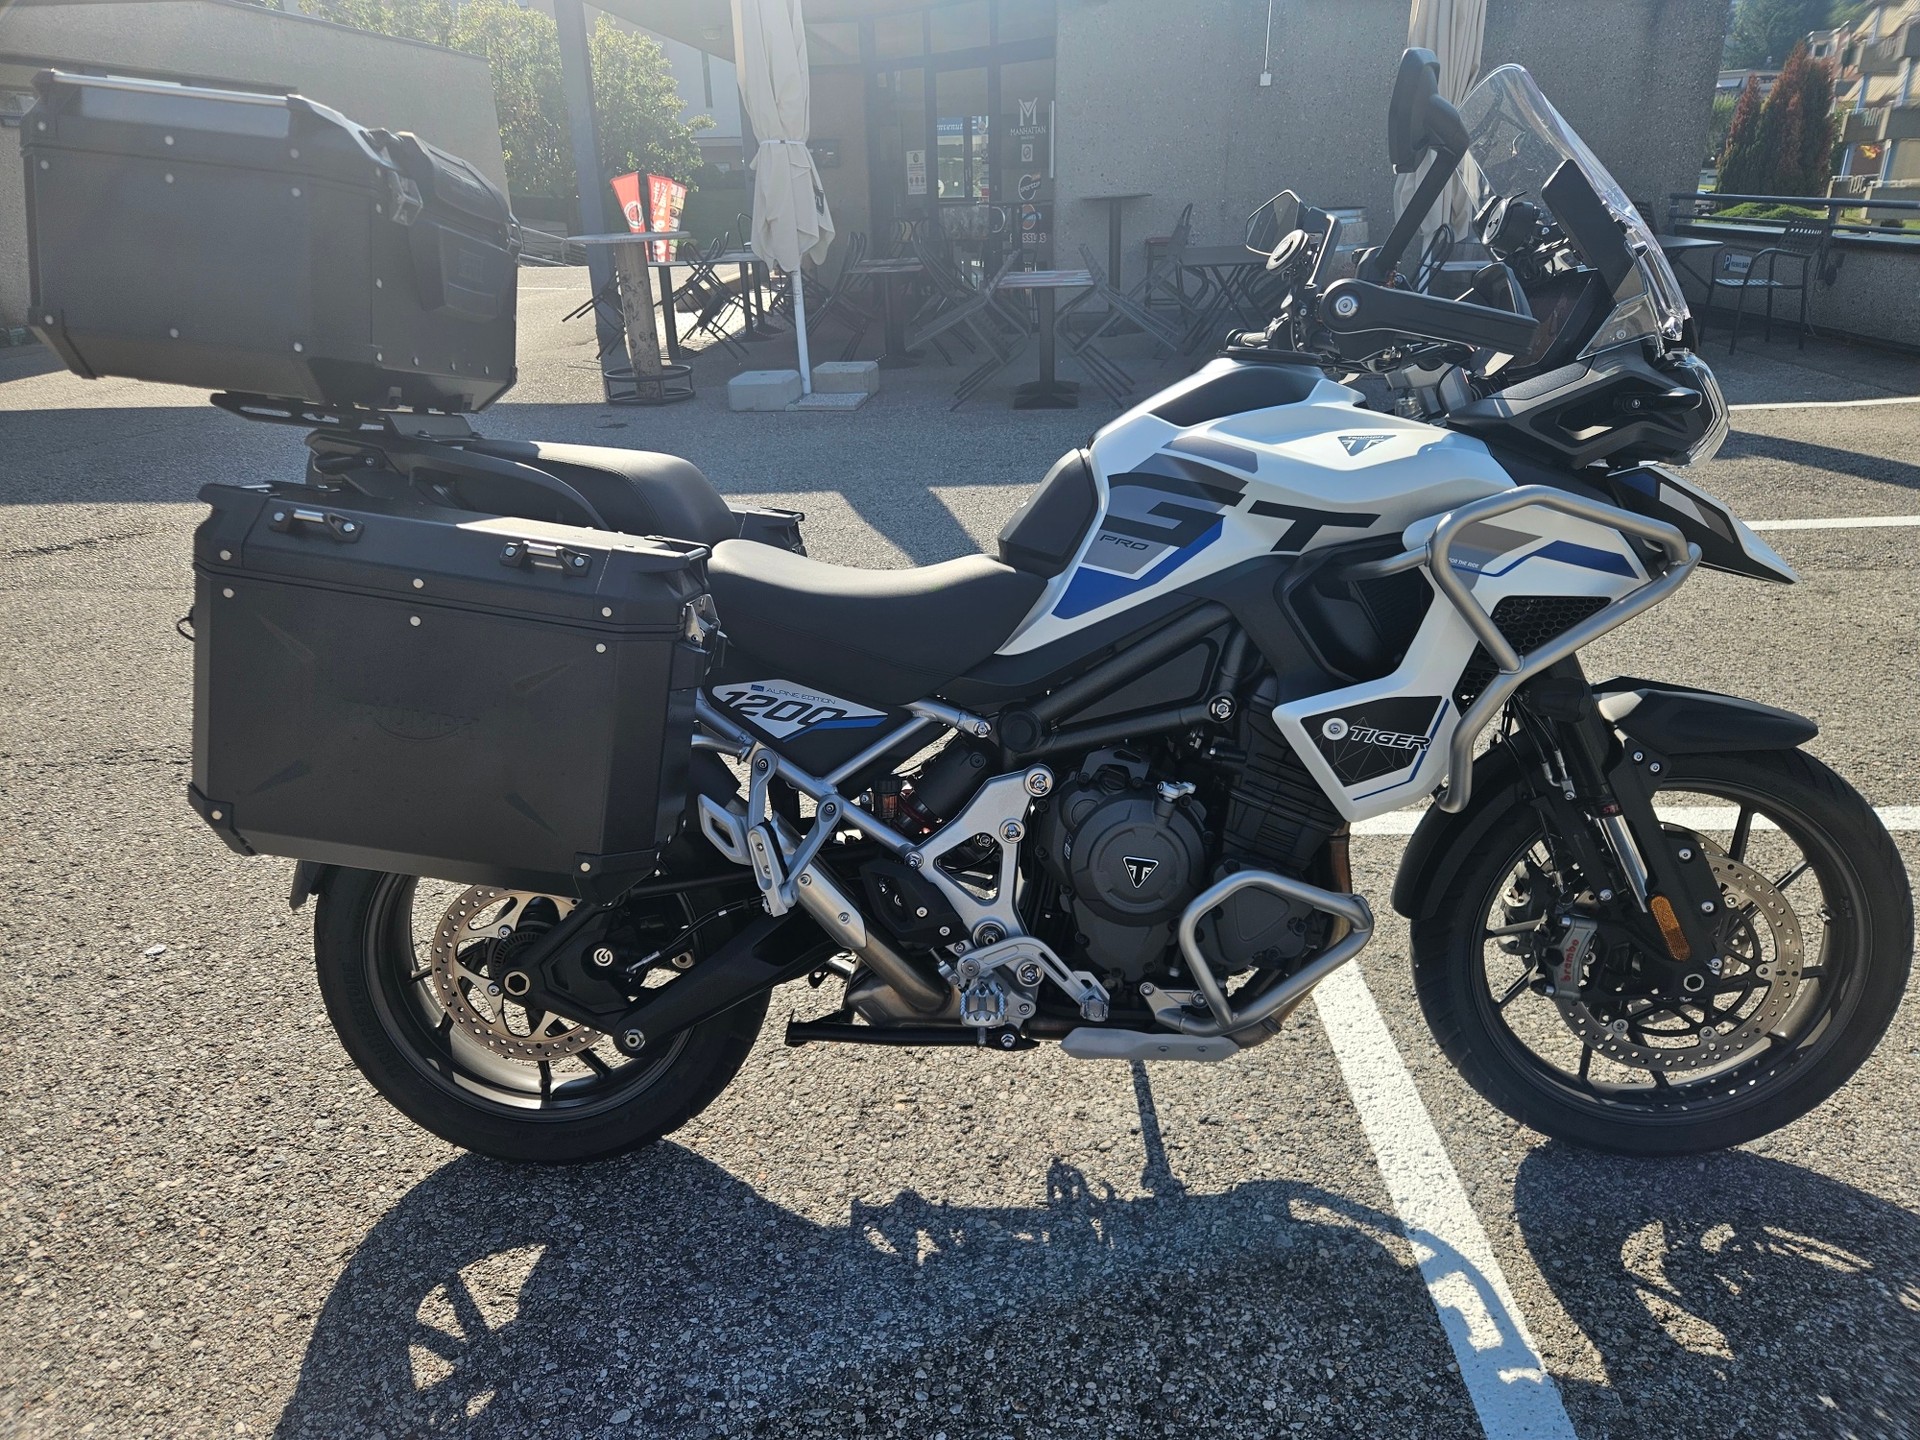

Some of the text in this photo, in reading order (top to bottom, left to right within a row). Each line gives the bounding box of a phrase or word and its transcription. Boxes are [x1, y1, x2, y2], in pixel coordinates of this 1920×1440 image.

[1010, 125, 1046, 136] MANHATTAN
[1099, 534, 1150, 551] PRO
[766, 687, 800, 699] ALPINE
[801, 693, 836, 705] EDITION
[723, 691, 848, 727] 1200
[1349, 725, 1431, 751] TIGER
[1561, 938, 1580, 982] brembo
